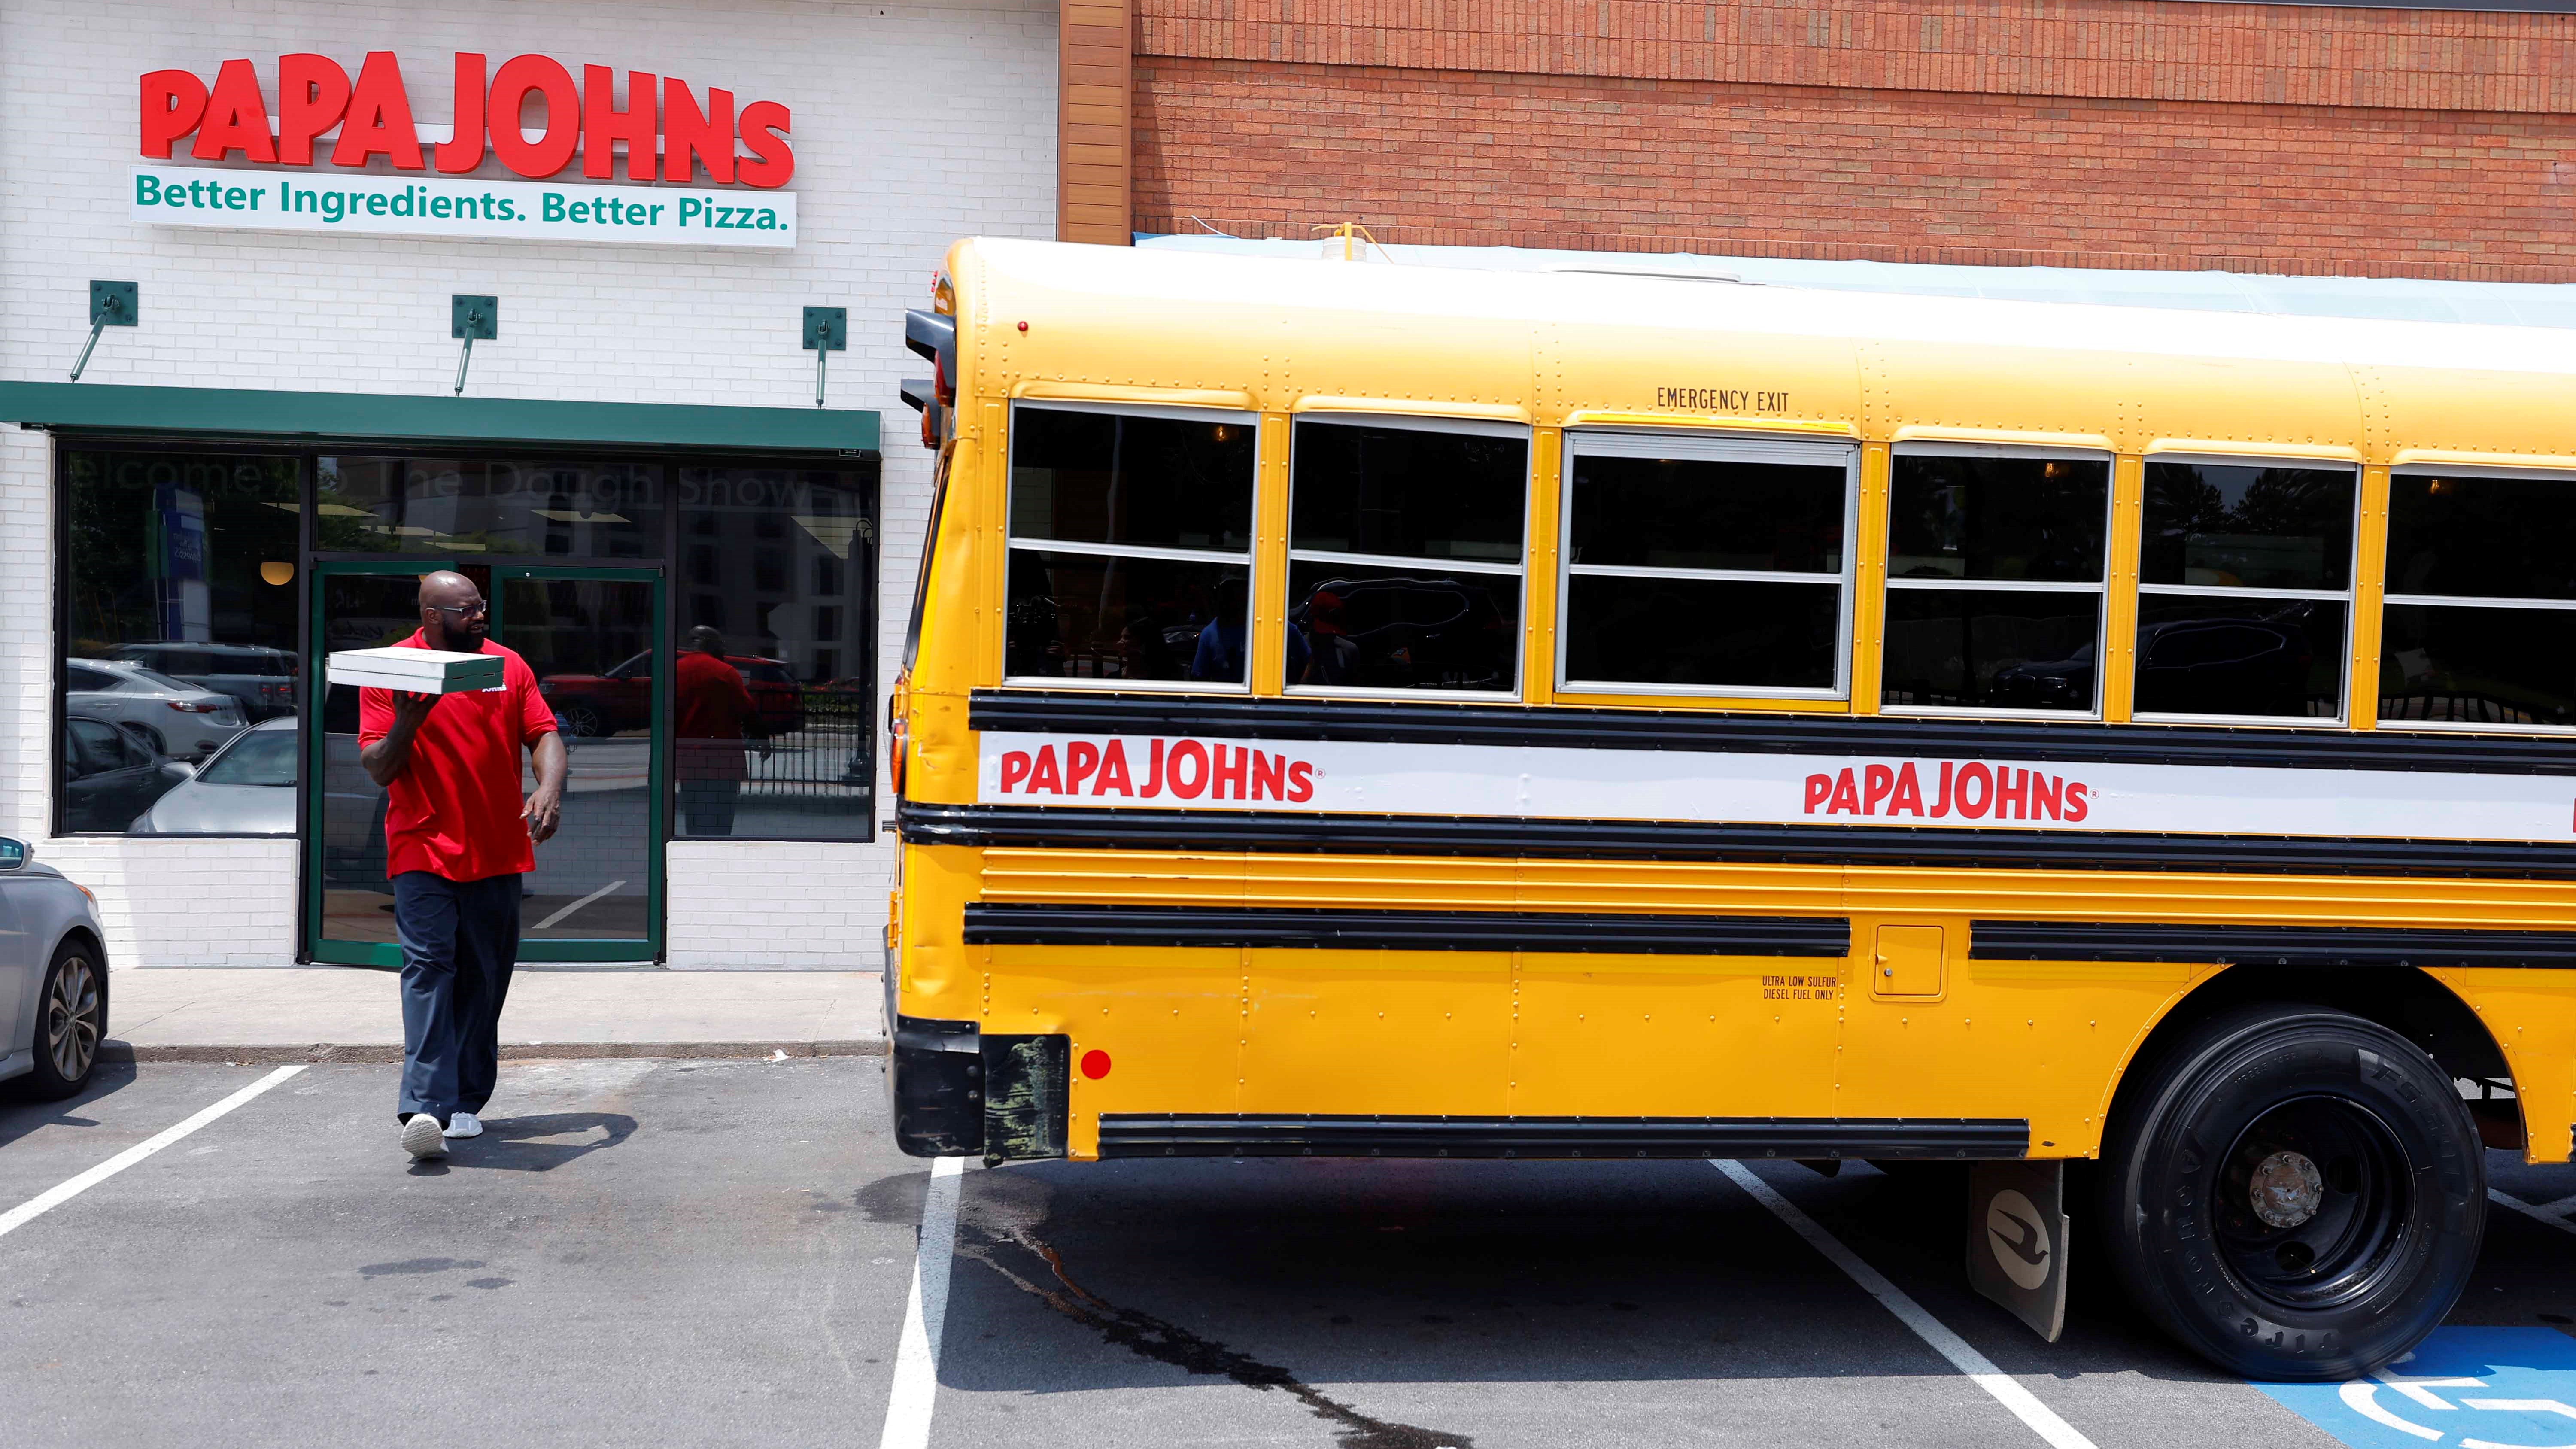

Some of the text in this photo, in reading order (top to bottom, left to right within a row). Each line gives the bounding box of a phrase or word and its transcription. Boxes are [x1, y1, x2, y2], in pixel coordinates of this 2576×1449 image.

[140, 51, 794, 189] PAPA JOHNS
[136, 174, 788, 231] Better Ingredients. Better Pizza.
[1657, 387, 1789, 412] EMERGENCY EXIT
[74, 453, 262, 493] elcome
[485, 461, 652, 514] Dough
[1001, 739, 1313, 802] PAPA JOHNS
[1804, 762, 2088, 822] PAPA JOHNS
[1762, 975, 1836, 987] ULTRA LOW SULFUR
[1764, 988, 1834, 1000] DIESEL FUEL ONLY
